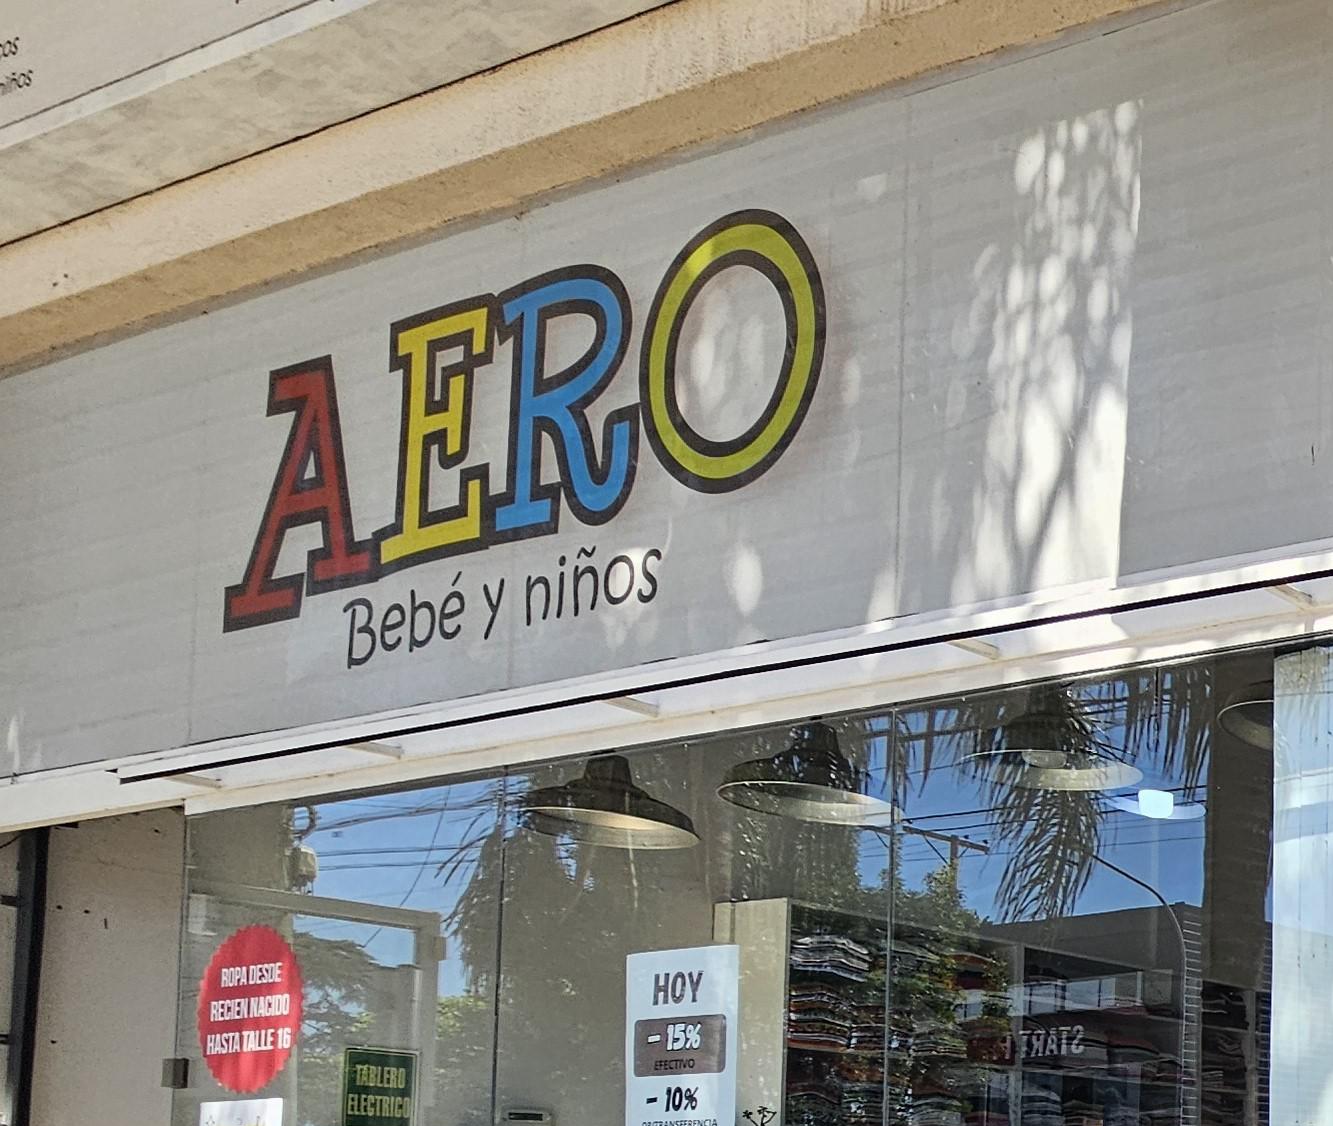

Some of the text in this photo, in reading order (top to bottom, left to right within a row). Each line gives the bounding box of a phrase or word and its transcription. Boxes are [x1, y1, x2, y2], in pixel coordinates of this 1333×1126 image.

[223, 209, 827, 633] AERO
[343, 546, 663, 668] Bebé y niños
[221, 962, 283, 988] ROPA DESDE
[652, 970, 704, 1006] HOY
[210, 993, 290, 1022] RECIEN NACIDO
[206, 1027, 291, 1055] HASTA TALLE 16
[355, 1064, 406, 1089] TABLERO
[654, 1059, 696, 1071] EFECTIVO
[347, 1093, 410, 1118] ELECTRICO
